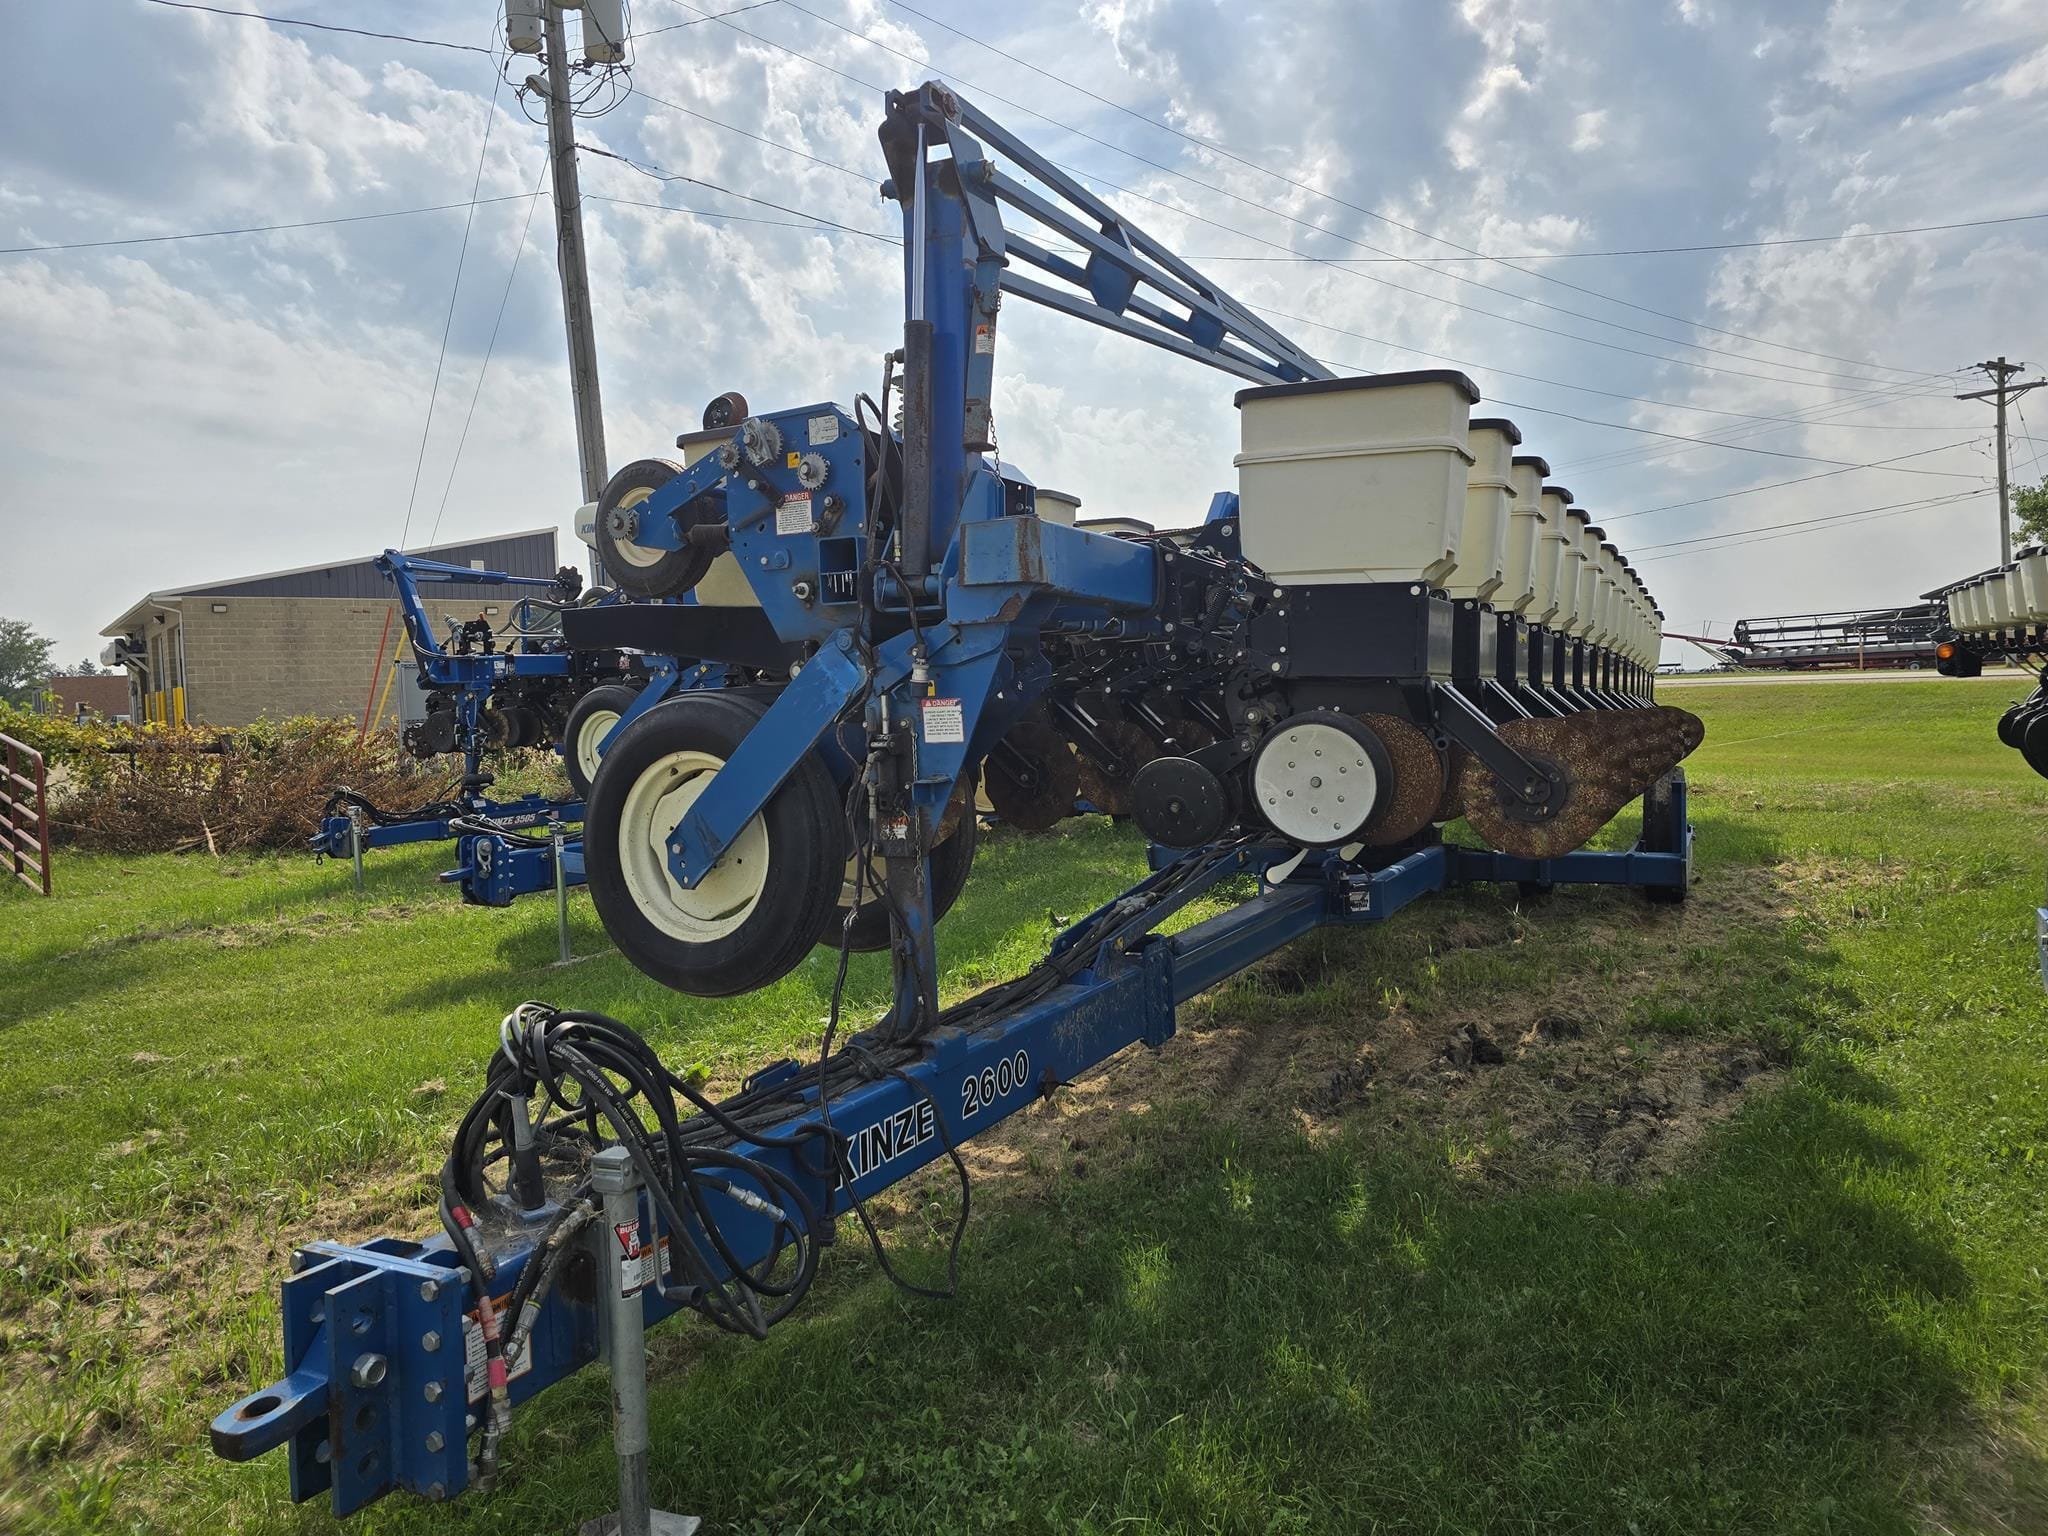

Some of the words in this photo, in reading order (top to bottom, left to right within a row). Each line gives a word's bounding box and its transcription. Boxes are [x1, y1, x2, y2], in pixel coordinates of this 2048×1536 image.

[785, 492, 809, 502] DANGER
[514, 814, 536, 823] 3505
[834, 1098, 935, 1192] KINZE
[961, 1049, 1029, 1121] 2600
